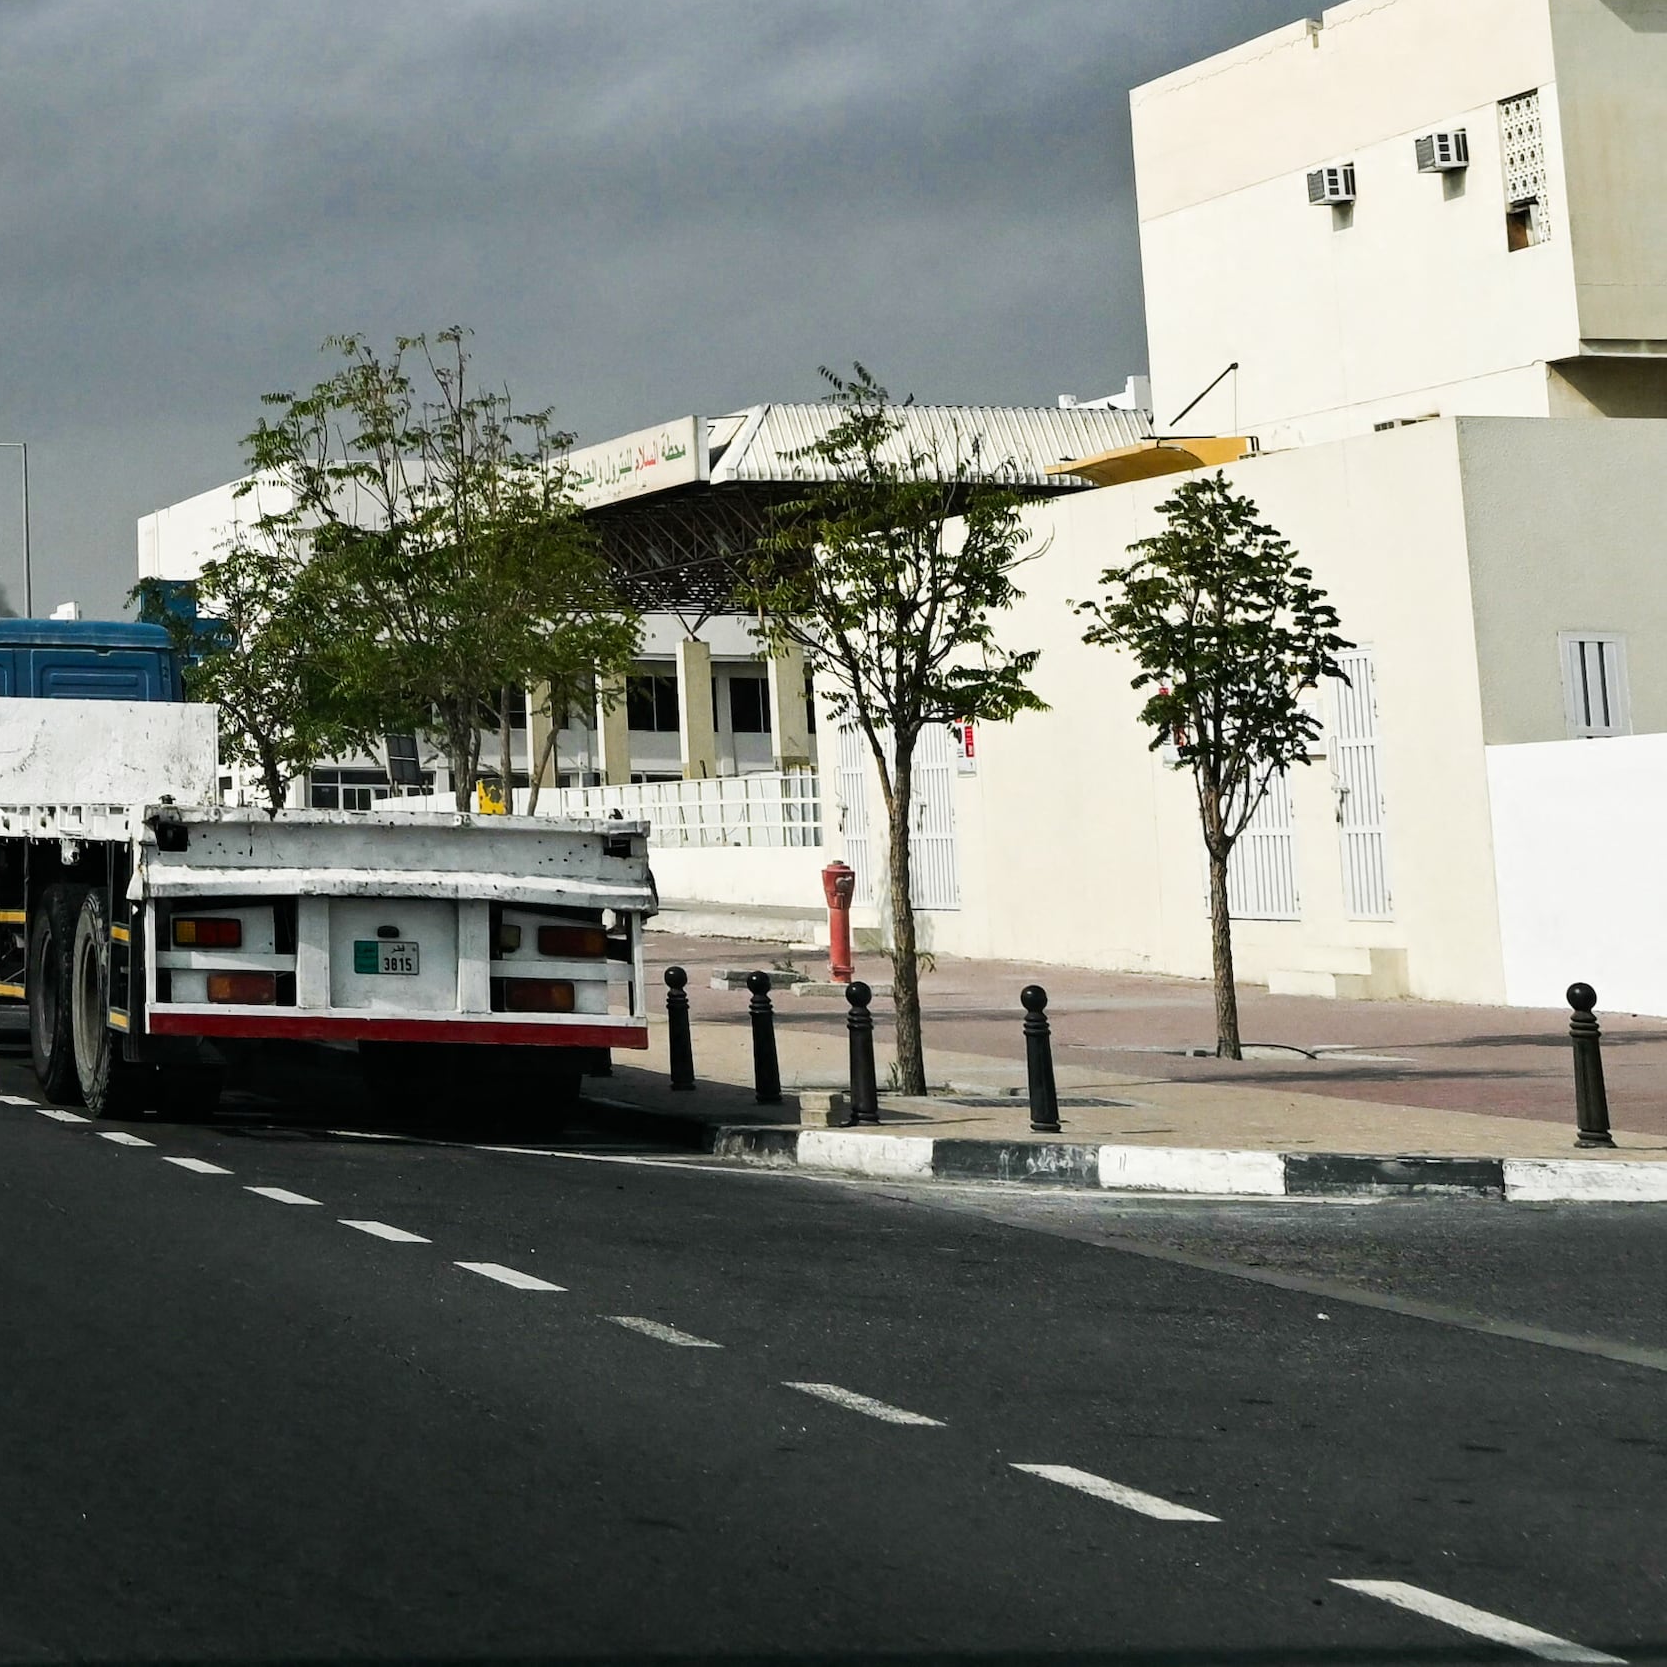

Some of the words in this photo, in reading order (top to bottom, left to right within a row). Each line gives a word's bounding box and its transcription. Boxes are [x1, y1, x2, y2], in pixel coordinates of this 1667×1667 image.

[661, 432, 687, 461] محطة
[635, 439, 659, 481] السلام
[391, 945, 405, 956] قطر
[384, 957, 412, 971] 3815
